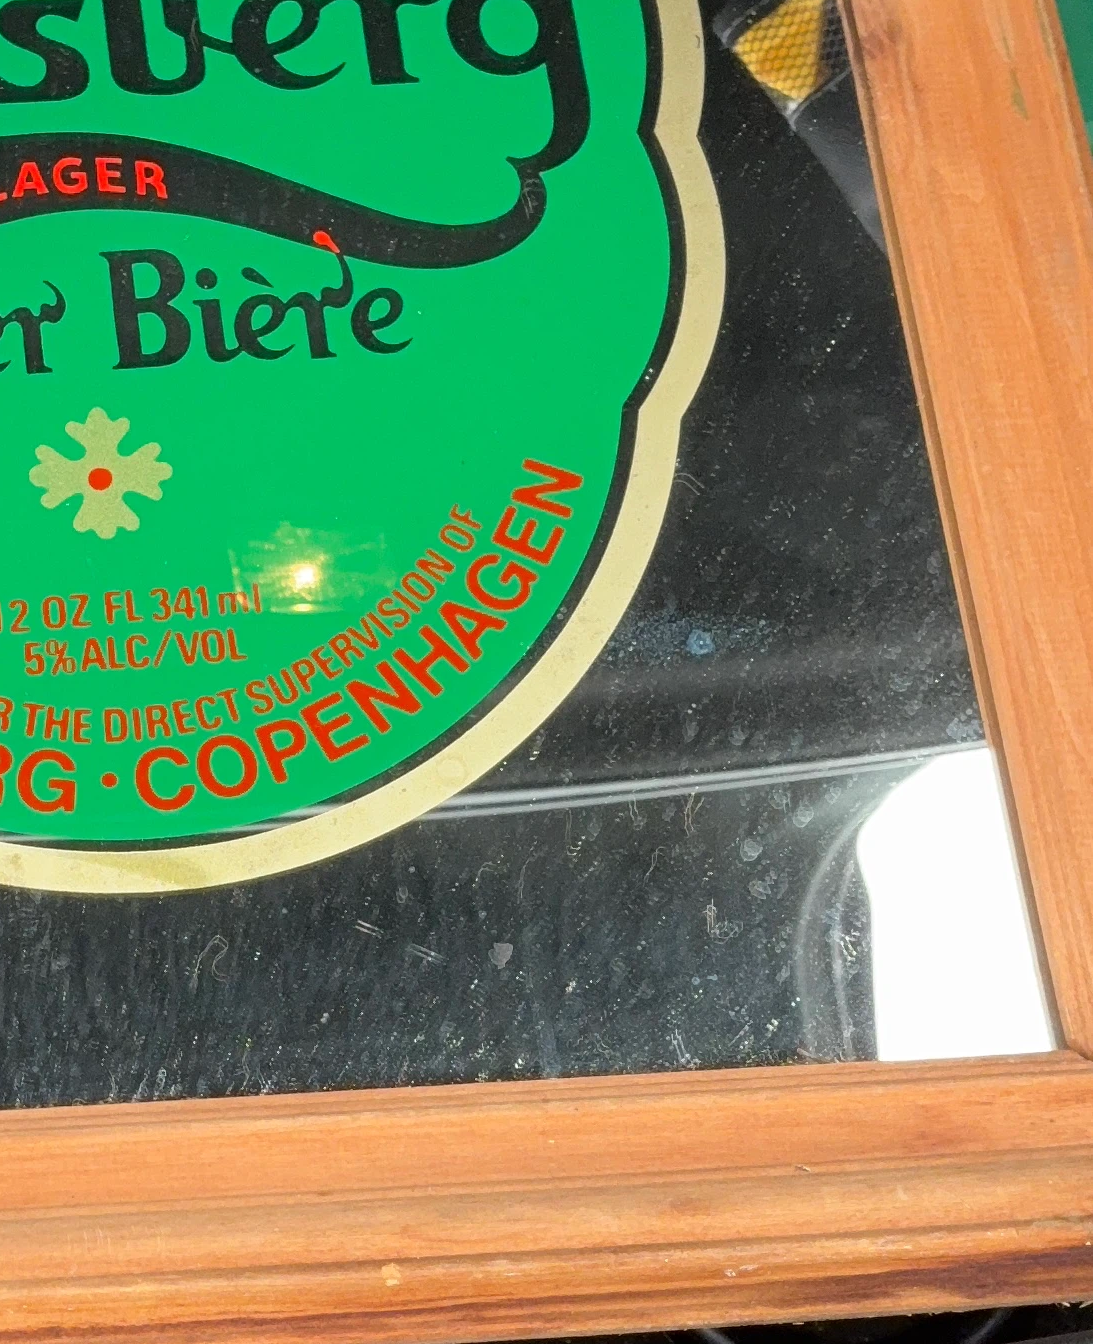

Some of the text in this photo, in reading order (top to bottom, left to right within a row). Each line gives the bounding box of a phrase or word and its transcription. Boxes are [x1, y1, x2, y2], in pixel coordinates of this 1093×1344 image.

[99, 230, 413, 371] Bière
[23, 702, 93, 744] THE
[103, 688, 240, 744] DIRECT
[245, 549, 456, 715] SUPERVISION
[439, 503, 483, 552] OF
[41, 593, 92, 630] OZ
[104, 589, 144, 625] FL
[149, 585, 209, 622] 341
[218, 582, 263, 615] ml
[134, 458, 584, 812] COPENHAGEN
